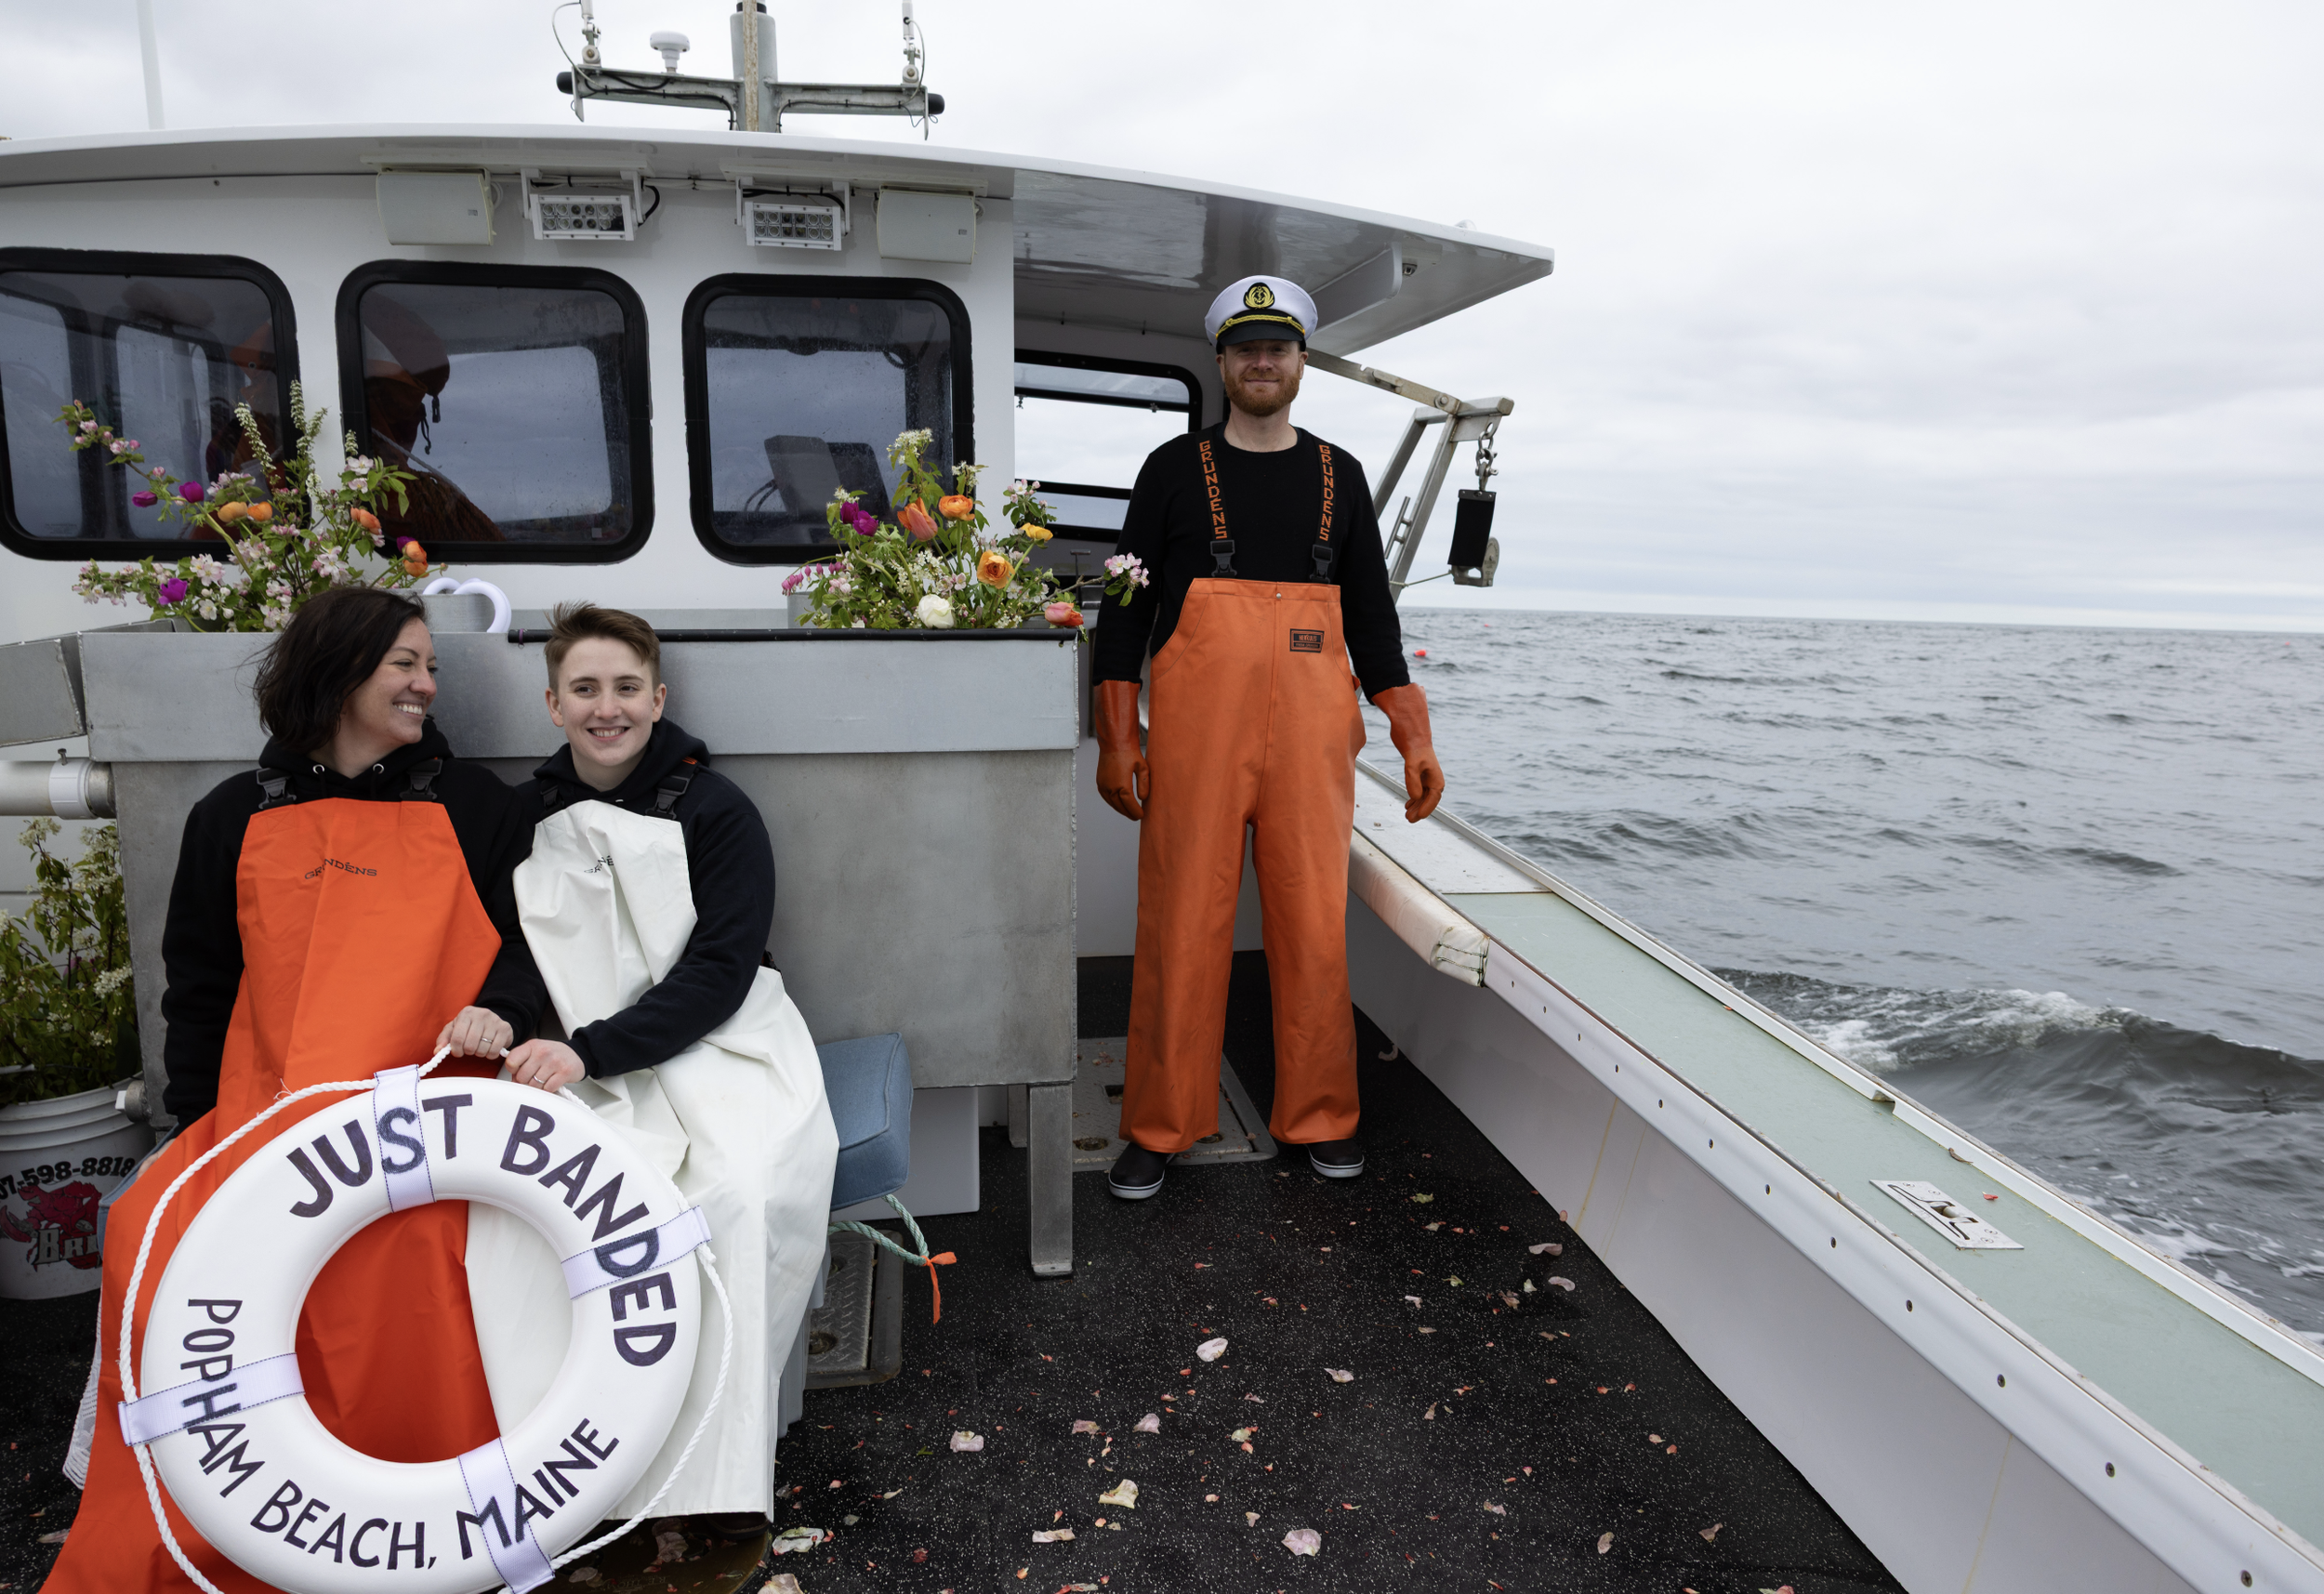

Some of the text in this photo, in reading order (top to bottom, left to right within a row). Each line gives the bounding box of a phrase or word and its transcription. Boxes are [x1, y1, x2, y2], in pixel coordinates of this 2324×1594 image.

[285, 1093, 677, 1368] JUST BANDED
[179, 1298, 620, 1571] POPHAM BEACH, MAINE
